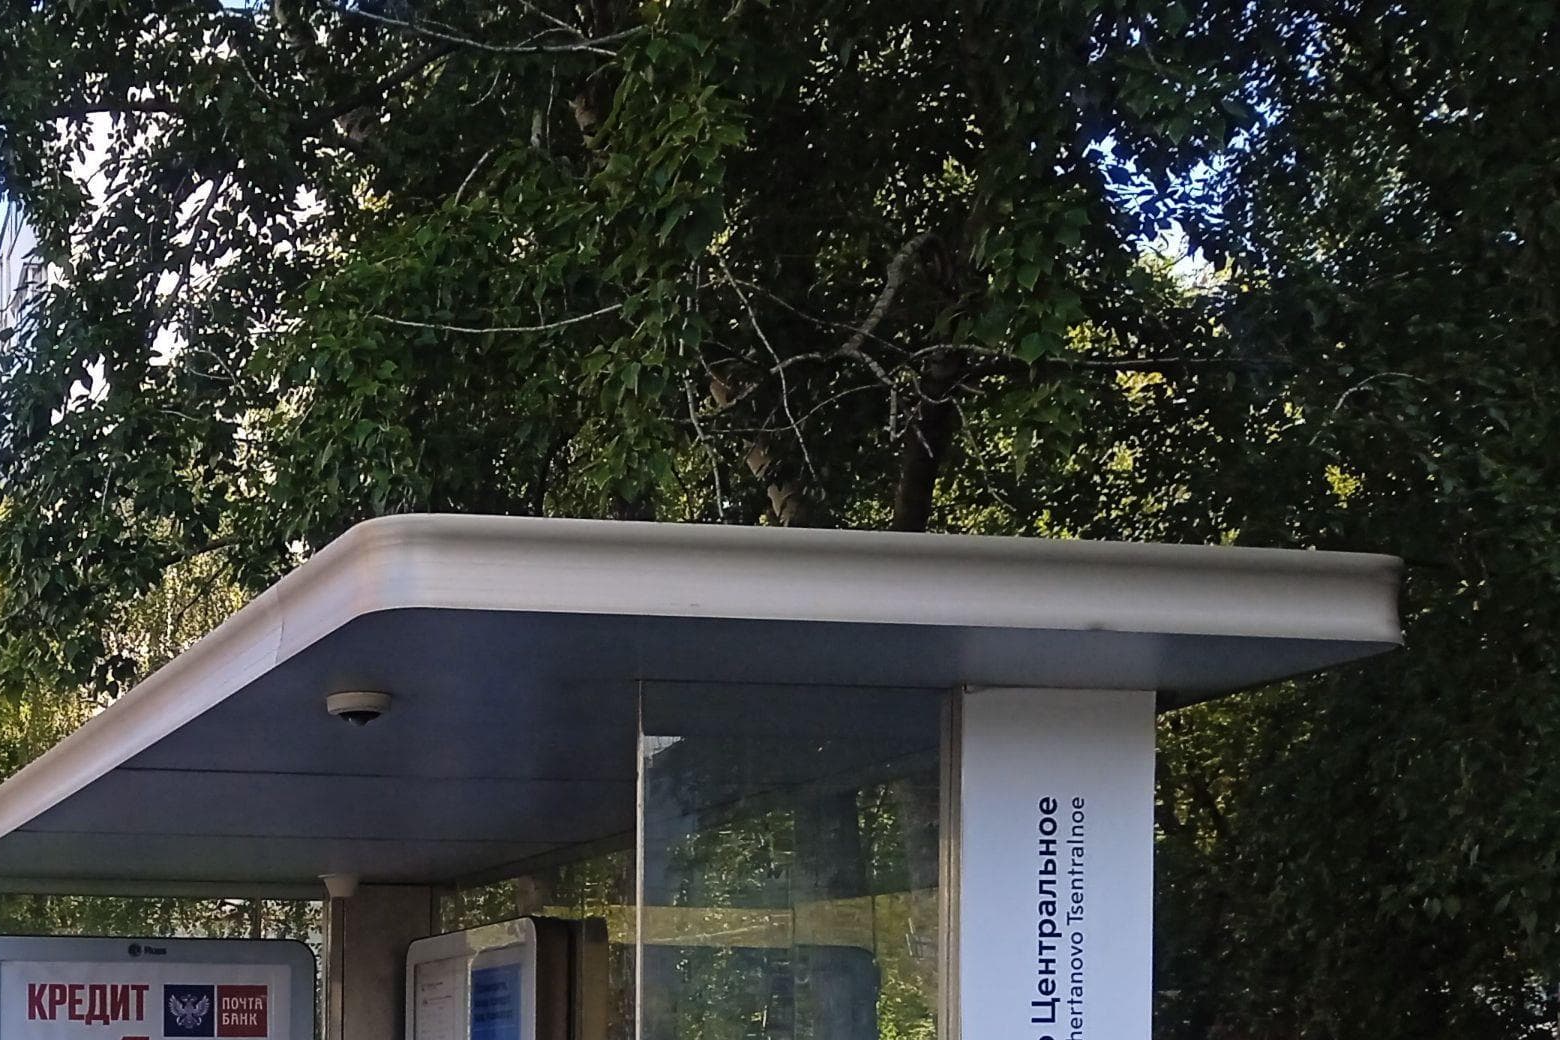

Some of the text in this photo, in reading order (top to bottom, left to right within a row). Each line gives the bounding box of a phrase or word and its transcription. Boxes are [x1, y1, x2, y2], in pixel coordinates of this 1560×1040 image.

[1066, 796, 1085, 926] Tsentralnoe
[1031, 796, 1063, 1024] Центральное
[28, 983, 149, 1026] КРЕДИТ
[222, 996, 264, 1011] ПОЧТА
[222, 1012, 259, 1027] БАНК
